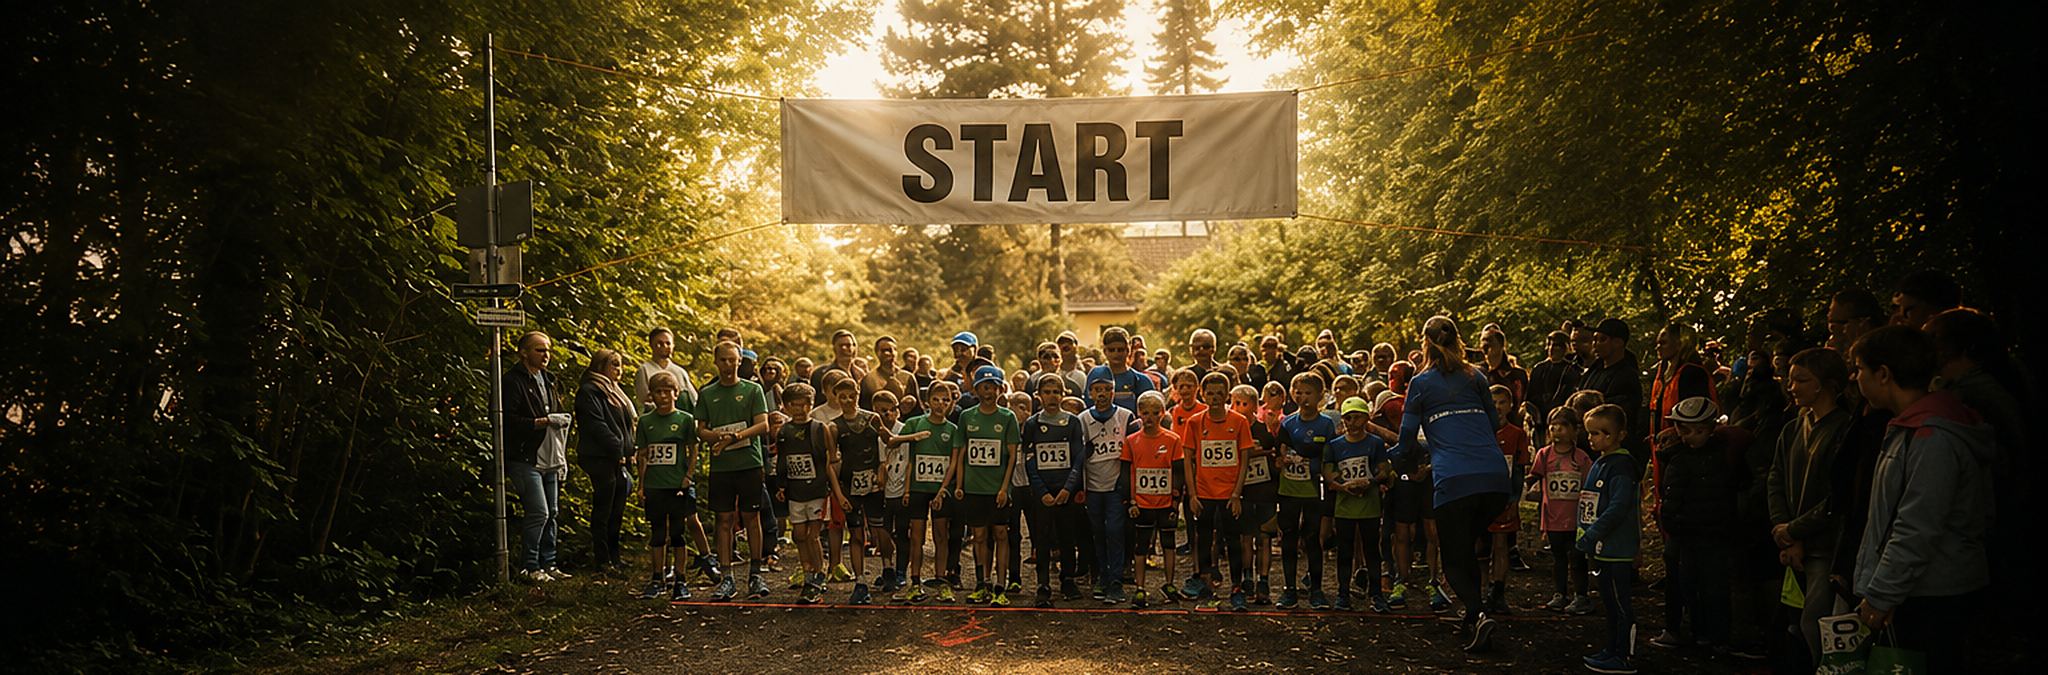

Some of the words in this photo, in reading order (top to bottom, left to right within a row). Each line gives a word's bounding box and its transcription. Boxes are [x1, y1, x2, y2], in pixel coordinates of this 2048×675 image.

[902, 119, 1184, 204] START
[1039, 450, 1067, 463] 013
[1203, 447, 1233, 461] 056
[1139, 475, 1168, 489] 016
